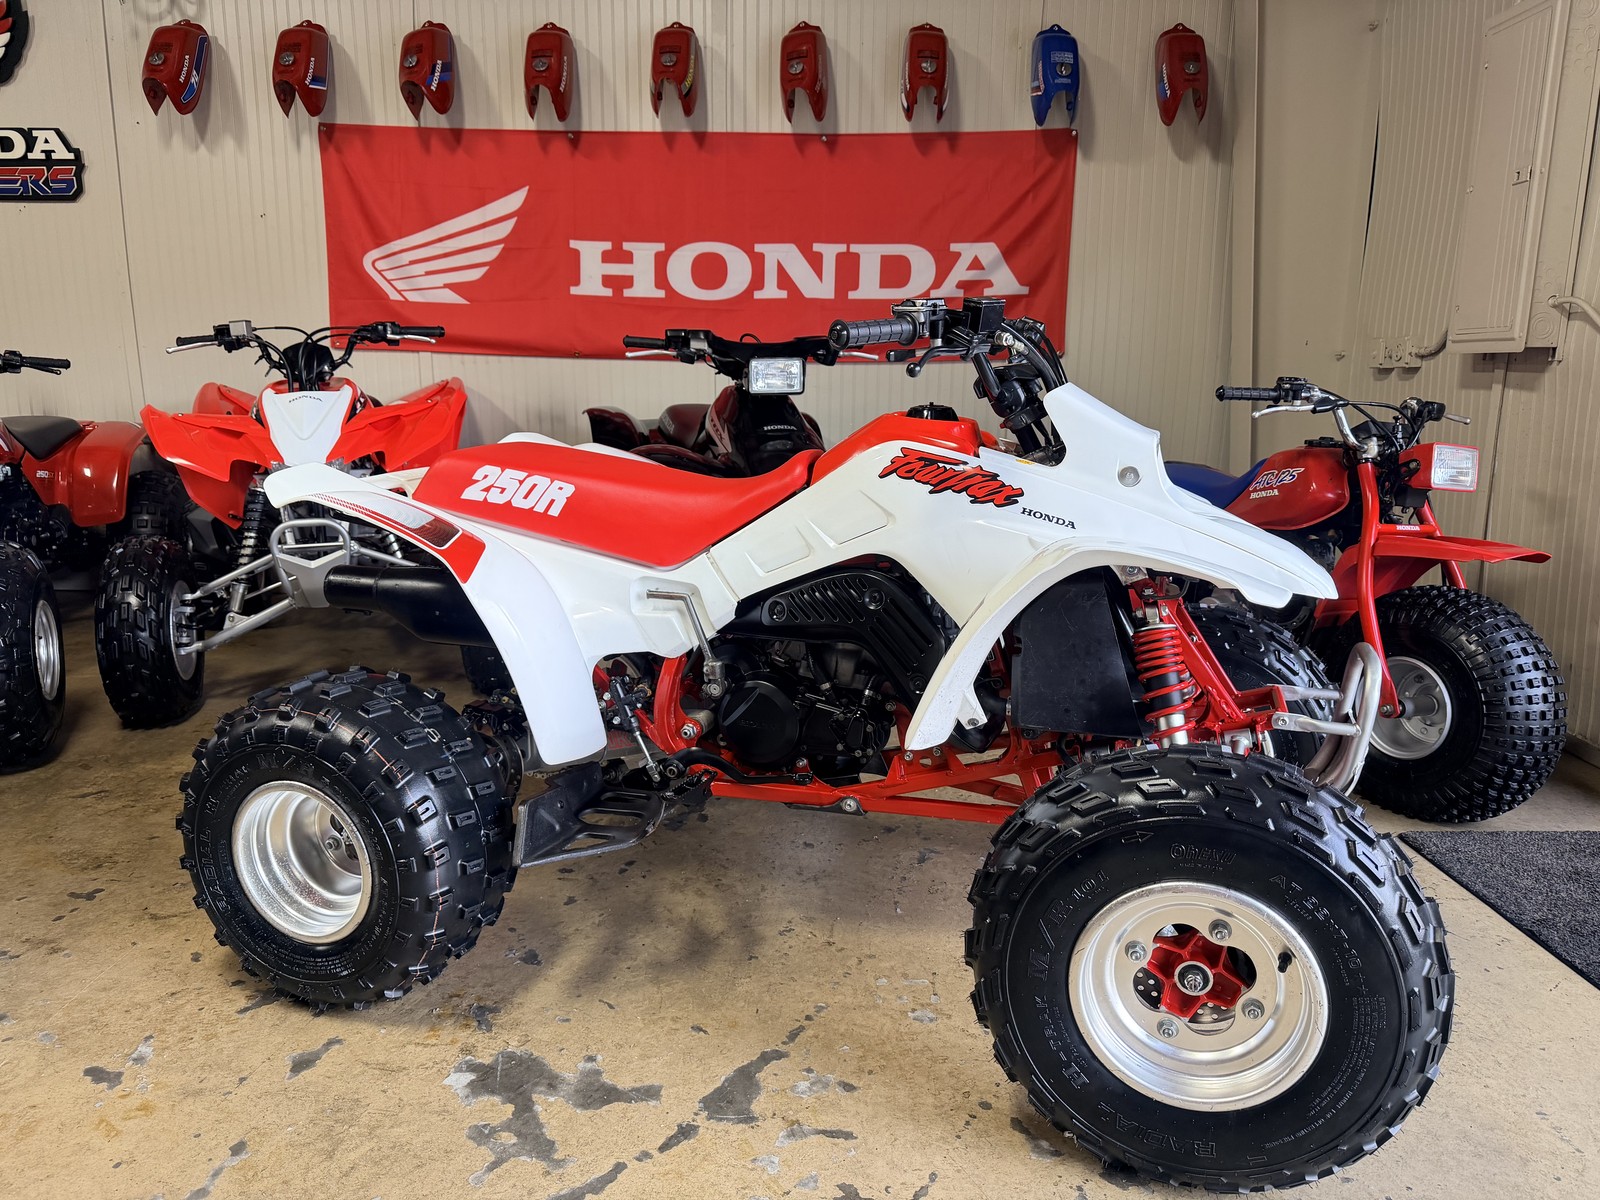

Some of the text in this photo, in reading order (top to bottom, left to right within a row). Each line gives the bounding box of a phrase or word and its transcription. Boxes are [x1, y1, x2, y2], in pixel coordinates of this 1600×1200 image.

[179, 55, 190, 84] HONDA
[304, 56, 316, 86] HONDA
[430, 59, 443, 91] HONDA
[1161, 63, 1171, 98] HONDA
[569, 239, 1030, 301] HONDA
[461, 464, 575, 517] 250R
[1250, 489, 1279, 499] HONDA
[1020, 507, 1077, 530] HONDA
